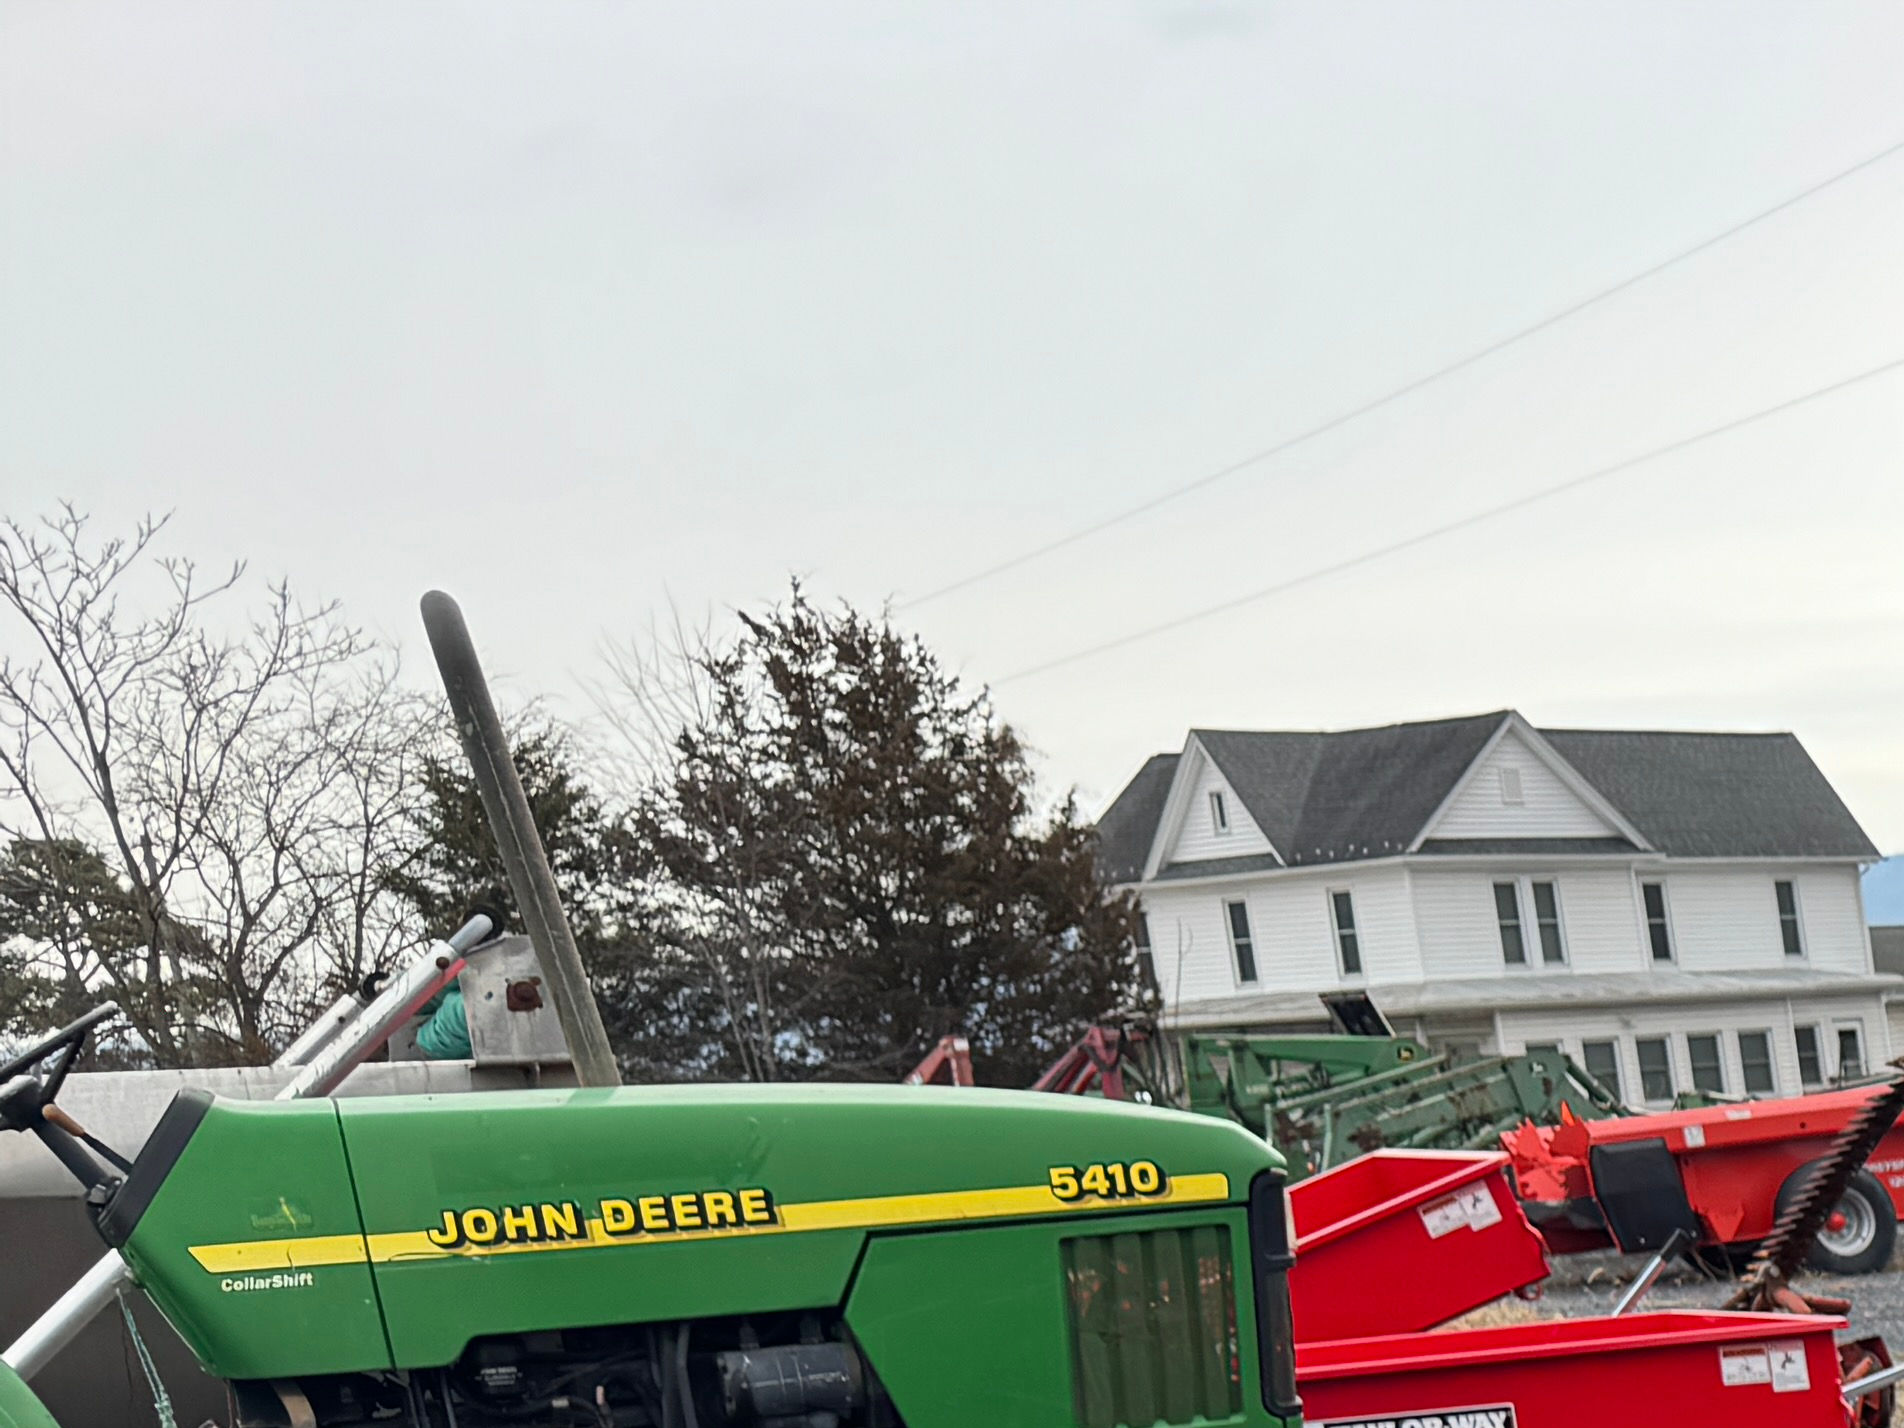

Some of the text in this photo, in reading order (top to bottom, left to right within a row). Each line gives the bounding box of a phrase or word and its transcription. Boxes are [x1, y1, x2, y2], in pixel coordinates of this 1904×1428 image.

[1049, 1160, 1162, 1199] 5410
[427, 1189, 773, 1247] JOHN DEERE
[221, 1272, 314, 1292] CollarShift
